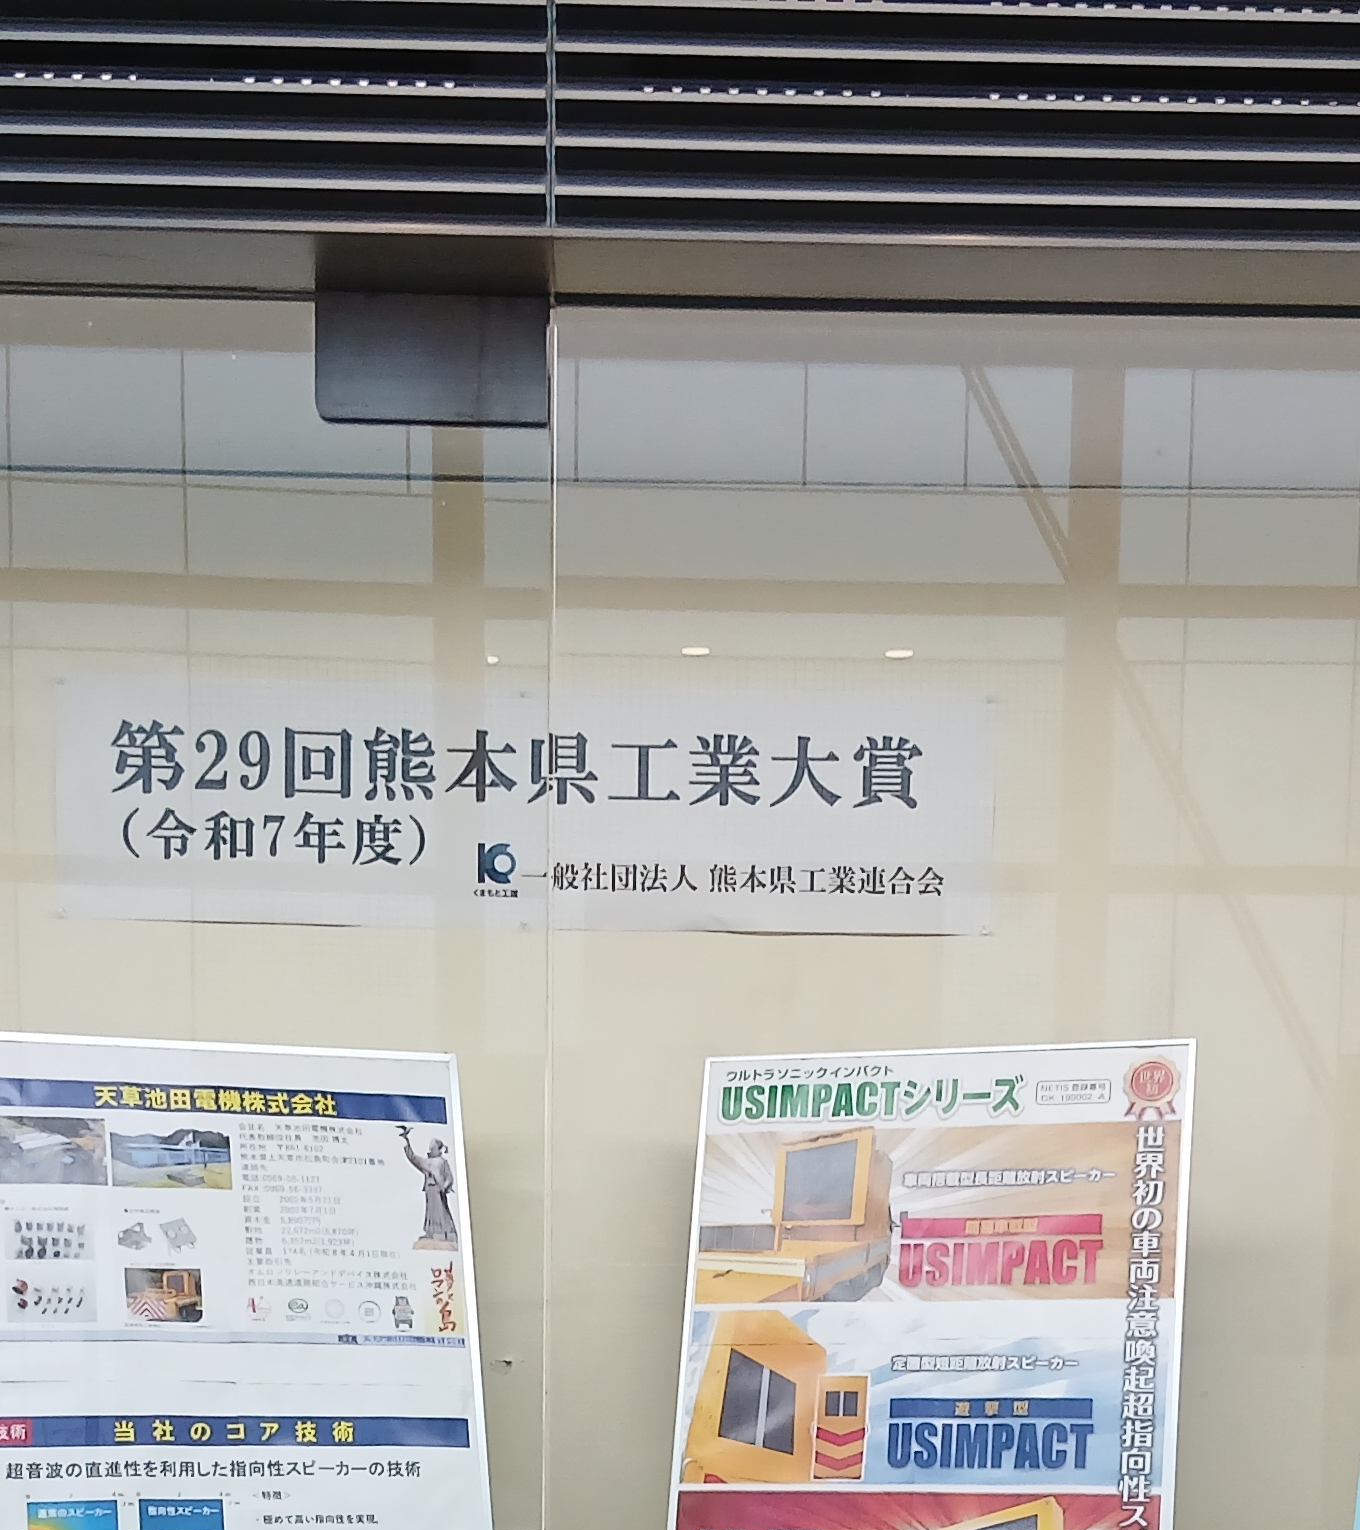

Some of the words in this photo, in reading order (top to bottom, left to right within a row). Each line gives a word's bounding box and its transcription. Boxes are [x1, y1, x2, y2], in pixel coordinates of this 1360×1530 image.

[111, 720, 924, 810] 第29回熊本県工業大賞
[521, 863, 698, 893] 一般社団法人
[709, 863, 945, 897] 熊本県工業連合会
[94, 1084, 338, 1117] 天草池田電機株式会社
[721, 1074, 1026, 1122] USIMPACTシリーズ
[899, 1239, 1103, 1288] USIMPACT
[113, 1421, 354, 1443] 当社のコア技術
[887, 1422, 1094, 1469] USIMPACT
[5, 1461, 422, 1480] 超音波の直進性を利用した指向性スピーカーの技術
